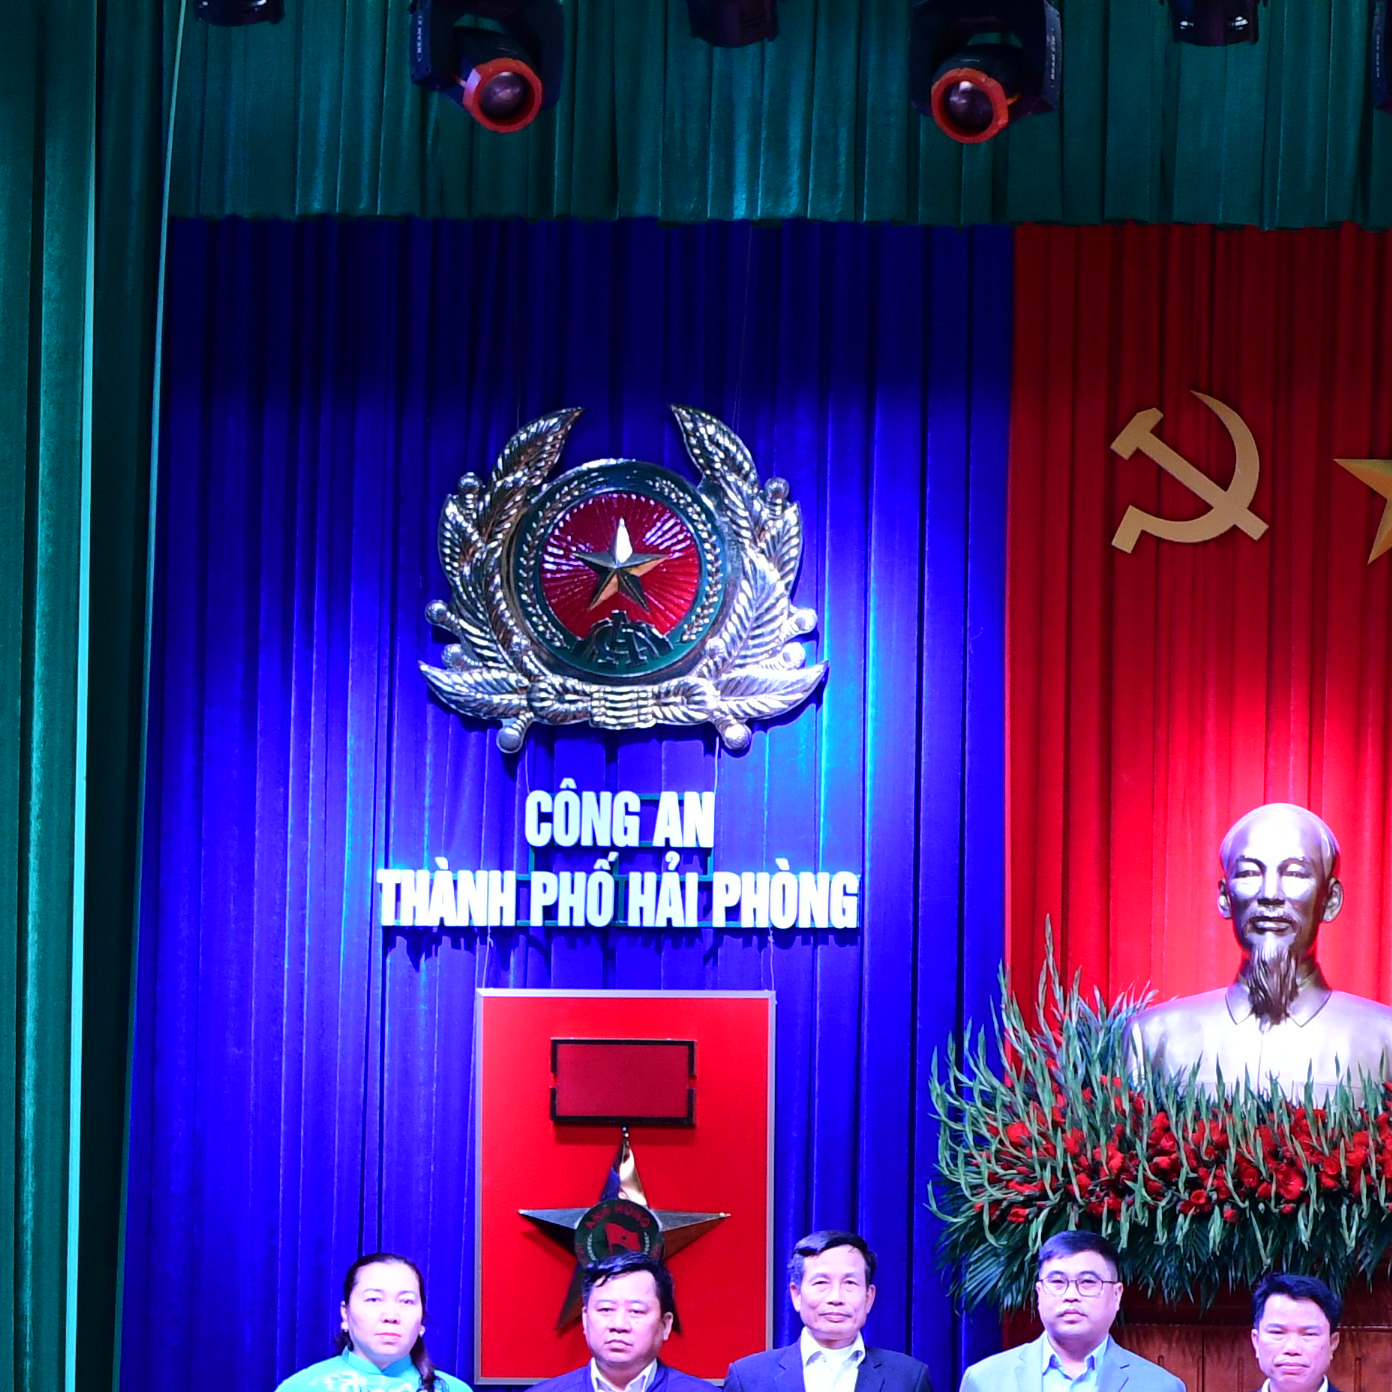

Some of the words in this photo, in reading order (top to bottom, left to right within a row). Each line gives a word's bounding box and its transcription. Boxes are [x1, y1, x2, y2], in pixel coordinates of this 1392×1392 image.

[525, 778, 640, 848] CÔNG
[653, 790, 716, 849] AN
[377, 857, 517, 927] THÀNH
[530, 850, 621, 928] PHỐ
[628, 851, 699, 929] HẢI
[712, 857, 860, 930] PHÒNG
